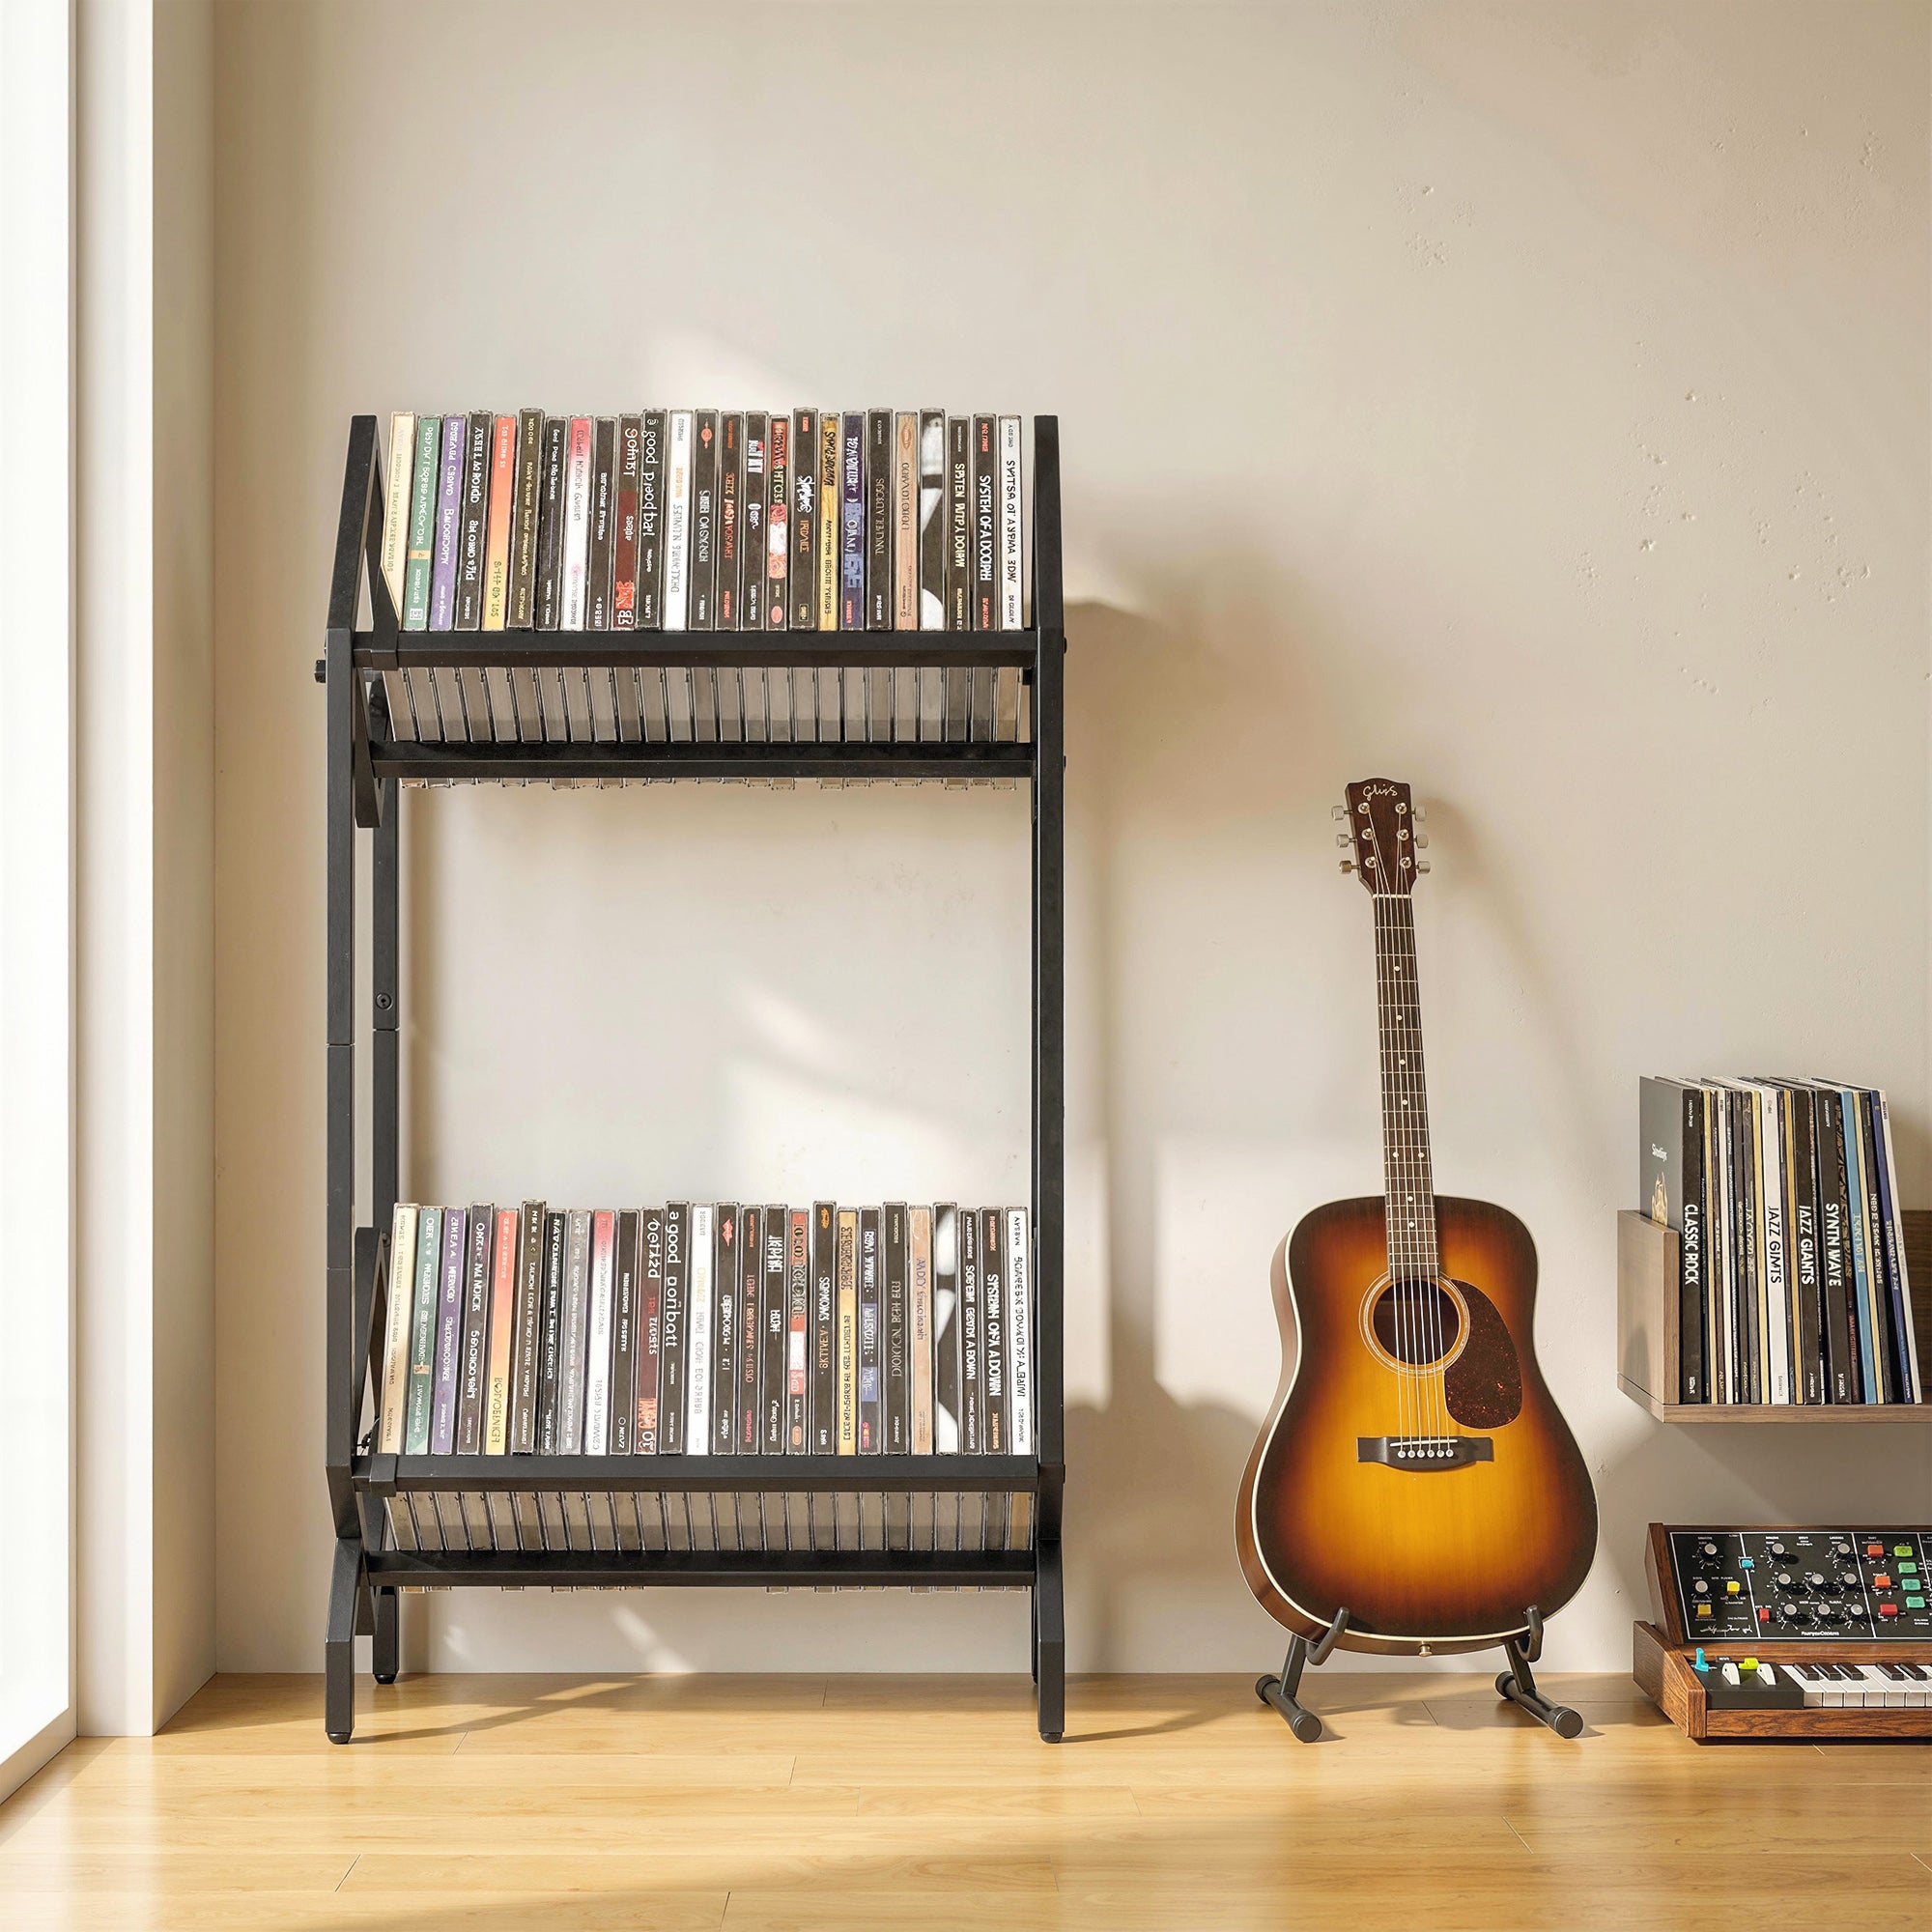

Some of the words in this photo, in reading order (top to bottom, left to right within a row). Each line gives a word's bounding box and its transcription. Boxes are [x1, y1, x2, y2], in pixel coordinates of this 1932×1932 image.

[1685, 1205, 1698, 1250] CLASSIC
[1768, 1206, 1780, 1236] JAZZ
[666, 1224, 681, 1264] good
[1685, 1253, 1698, 1285] ROCK
